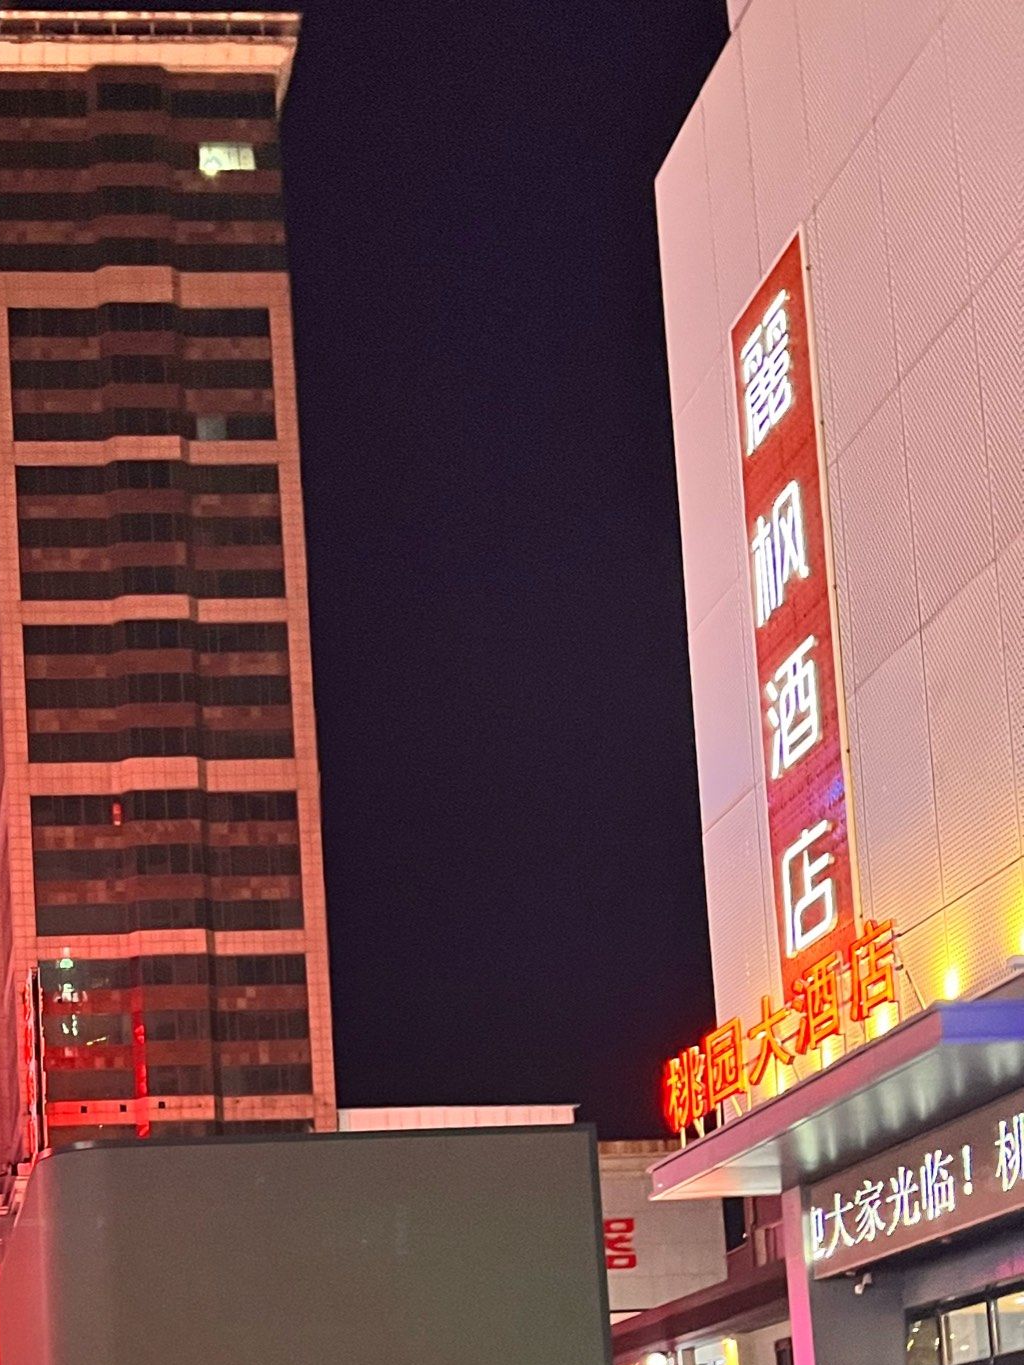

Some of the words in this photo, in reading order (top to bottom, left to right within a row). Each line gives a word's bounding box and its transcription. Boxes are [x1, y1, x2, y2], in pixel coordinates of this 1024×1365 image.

[664, 919, 896, 1133] 桃园大酒店
